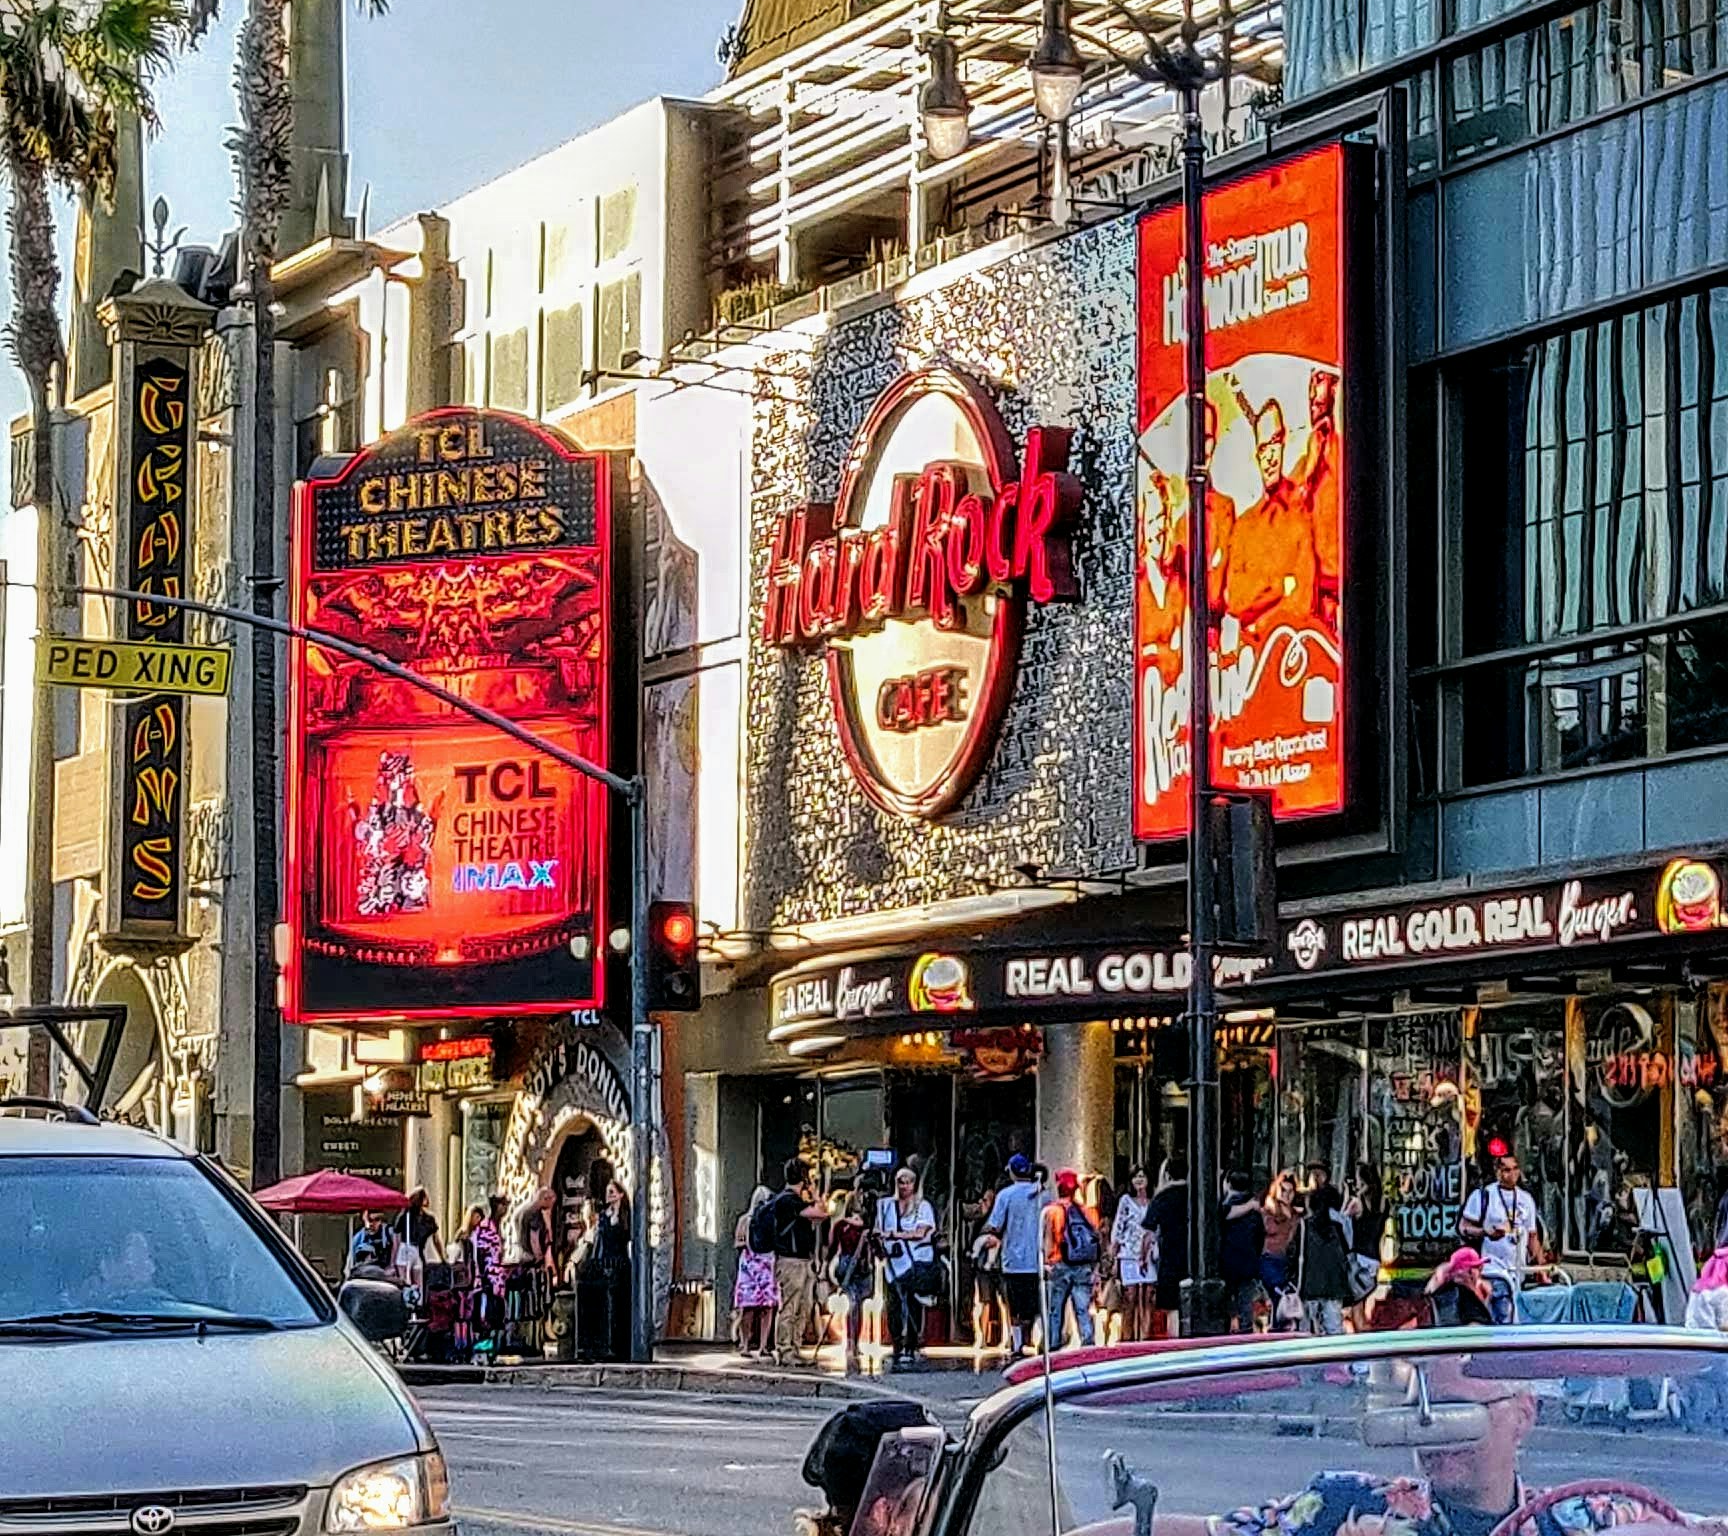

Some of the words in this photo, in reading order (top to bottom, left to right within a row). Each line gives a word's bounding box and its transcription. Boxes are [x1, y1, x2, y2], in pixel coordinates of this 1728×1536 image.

[416, 421, 494, 463] TCL
[359, 460, 551, 514] CHINESE
[340, 504, 566, 562] THEATRES
[761, 472, 908, 645] Hard
[908, 426, 1064, 630] Rock
[133, 376, 184, 900] GRAUANS
[49, 646, 118, 678] PED
[134, 651, 216, 686] XING
[877, 667, 969, 732] CAFE
[453, 760, 557, 804] TCL
[454, 805, 556, 837] CHINESE
[454, 833, 556, 864] THEATRE
[452, 860, 558, 892] IMAX
[1343, 916, 1404, 960] REAL
[1484, 895, 1553, 944] REAL
[1558, 879, 1638, 947] Burger.
[797, 978, 833, 1015] REAL
[835, 966, 894, 1020] Burger.
[1005, 956, 1094, 996] REAL
[570, 1008, 600, 1026] TCL
[1400, 1204, 1459, 1238] TOGE
